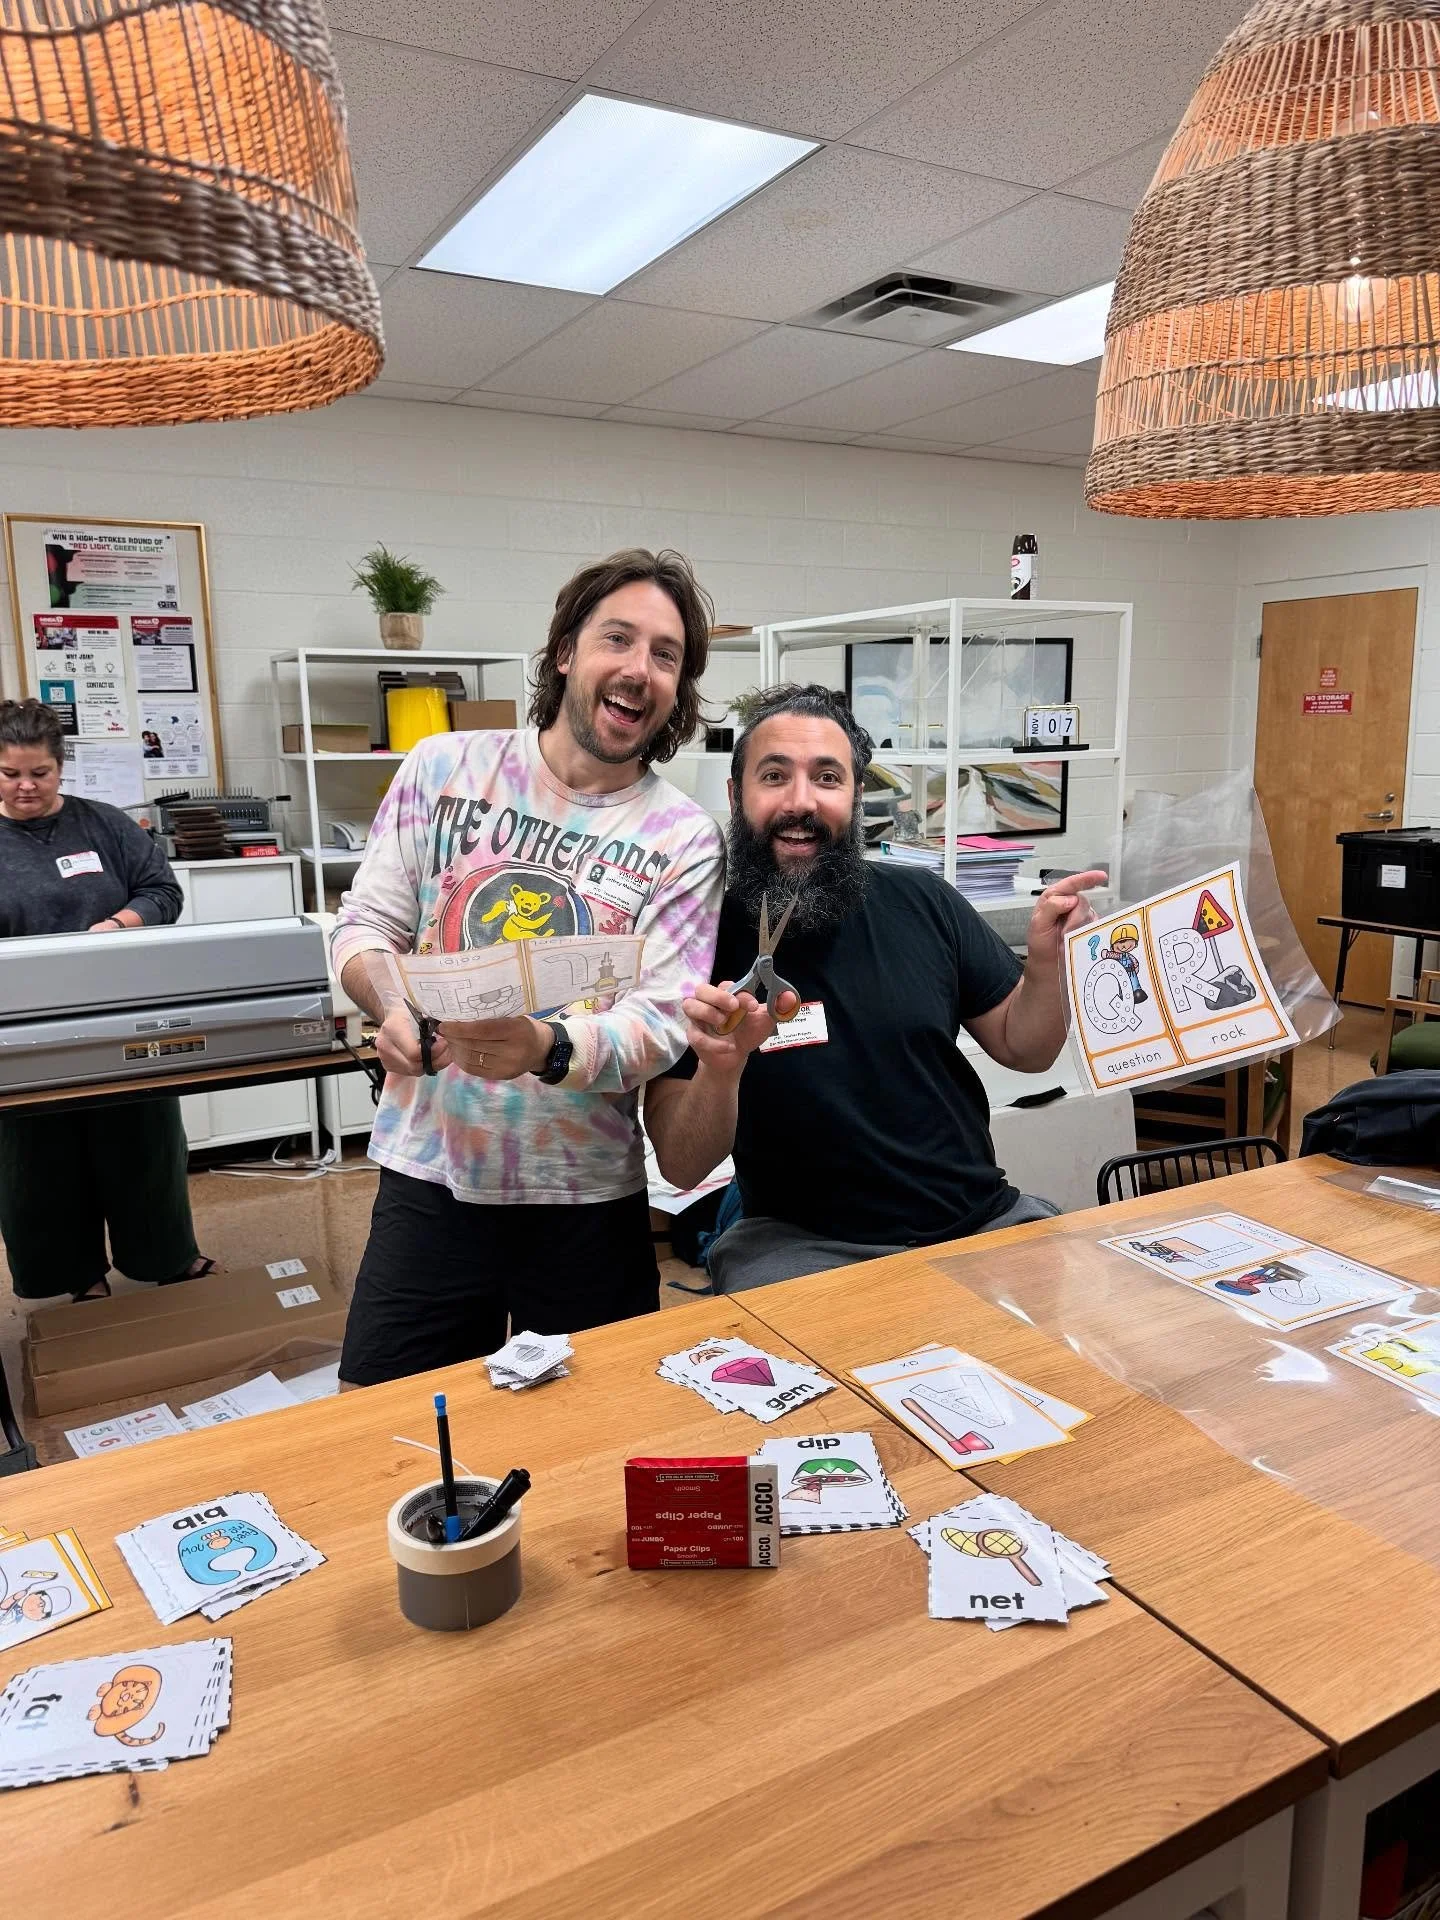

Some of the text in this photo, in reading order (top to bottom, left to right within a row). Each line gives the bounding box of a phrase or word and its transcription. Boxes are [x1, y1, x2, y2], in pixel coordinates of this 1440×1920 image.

[52, 533, 67, 541] WIN
[76, 535, 126, 543] HIGH-STAKES
[128, 536, 153, 545] ROUND
[154, 537, 164, 545] OF
[114, 544, 138, 552] GREEN
[1031, 718, 1039, 735] NOV
[430, 795, 492, 880] THE
[490, 806, 600, 875] OTHER
[619, 870, 644, 886] VISITOR
[1159, 927, 1221, 1013] R
[1083, 958, 1143, 1035] Q
[1211, 1024, 1247, 1045] rock
[1107, 1051, 1162, 1074] question
[765, 1383, 815, 1411] gem
[797, 1437, 841, 1450] dip
[172, 1505, 228, 1530] bib
[655, 1511, 722, 1521] Paper Clips
[181, 1543, 205, 1557] now
[663, 1545, 711, 1553] Paper Clips
[969, 1592, 1025, 1610] net
